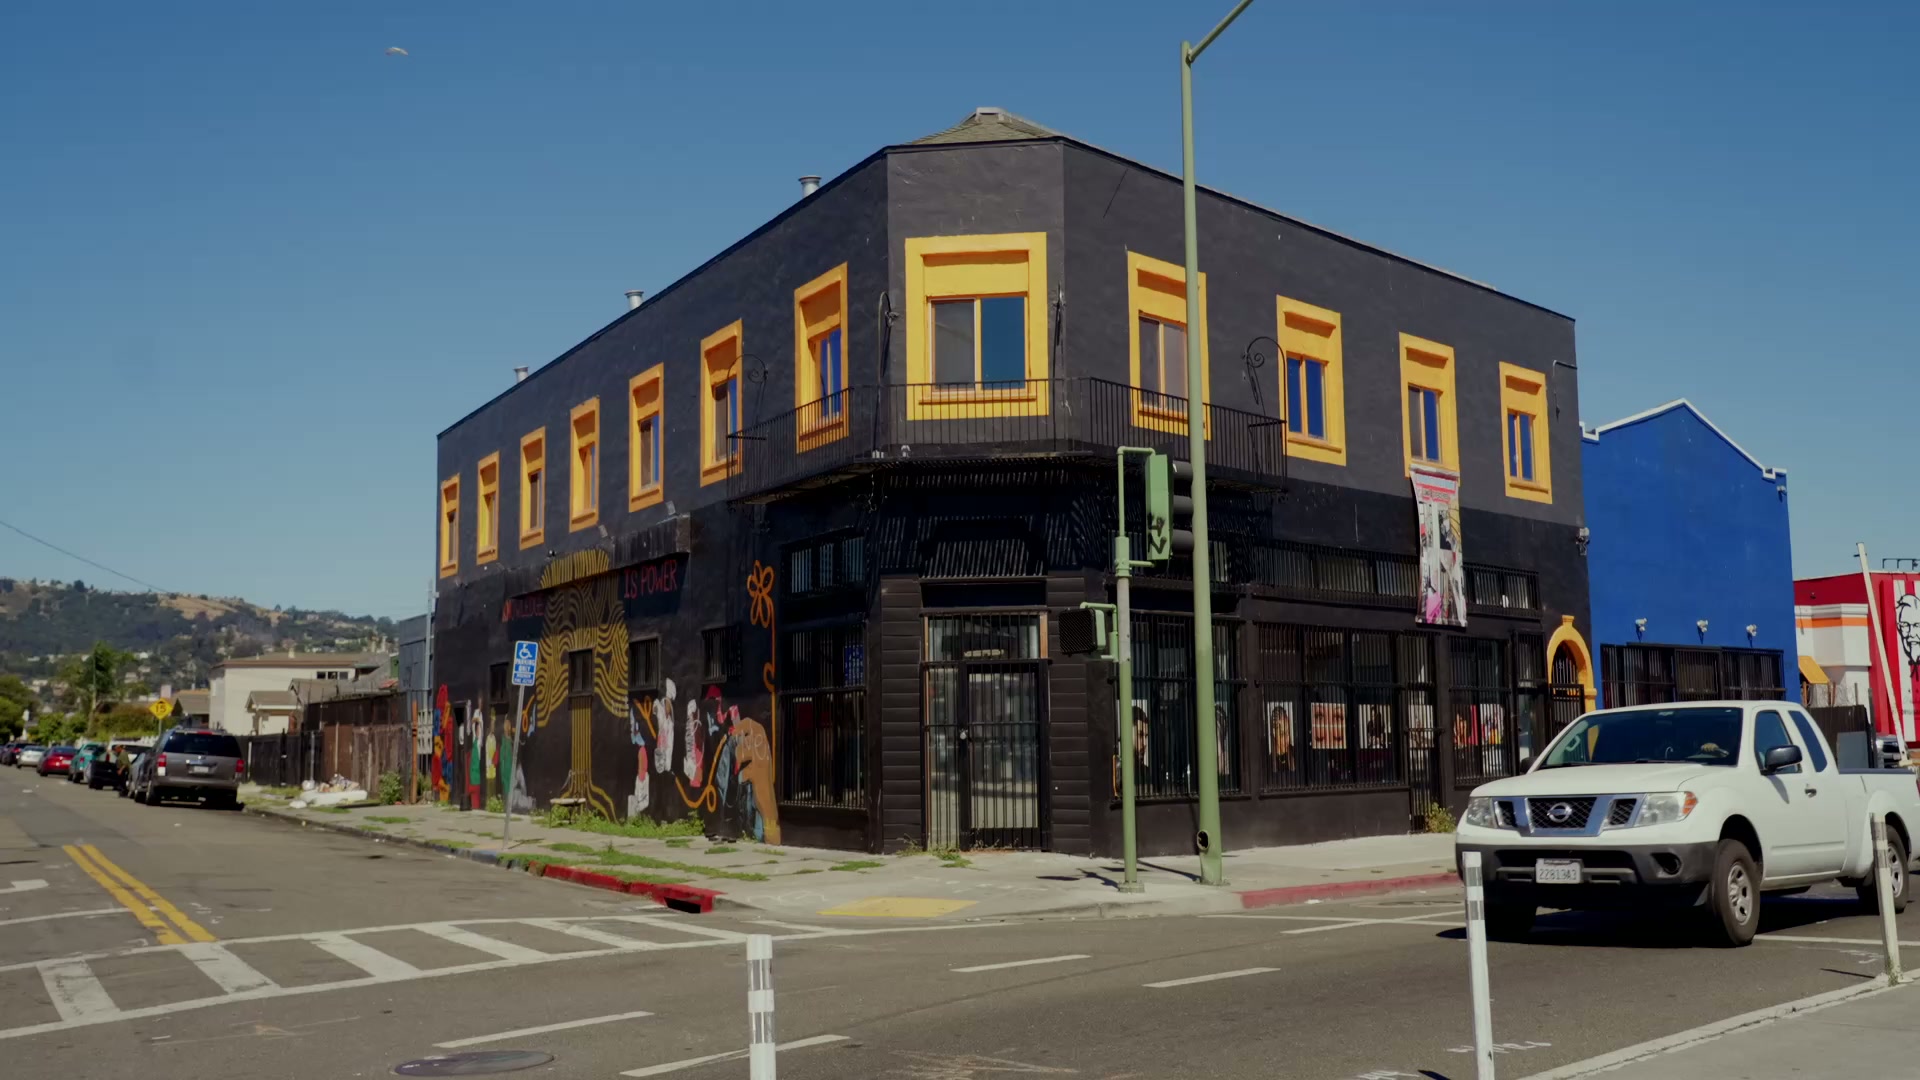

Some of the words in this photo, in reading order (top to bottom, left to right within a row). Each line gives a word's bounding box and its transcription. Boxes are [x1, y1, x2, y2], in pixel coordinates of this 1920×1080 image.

[624, 568, 638, 599] IS
[641, 559, 678, 596] POWER
[155, 704, 167, 713] 15
